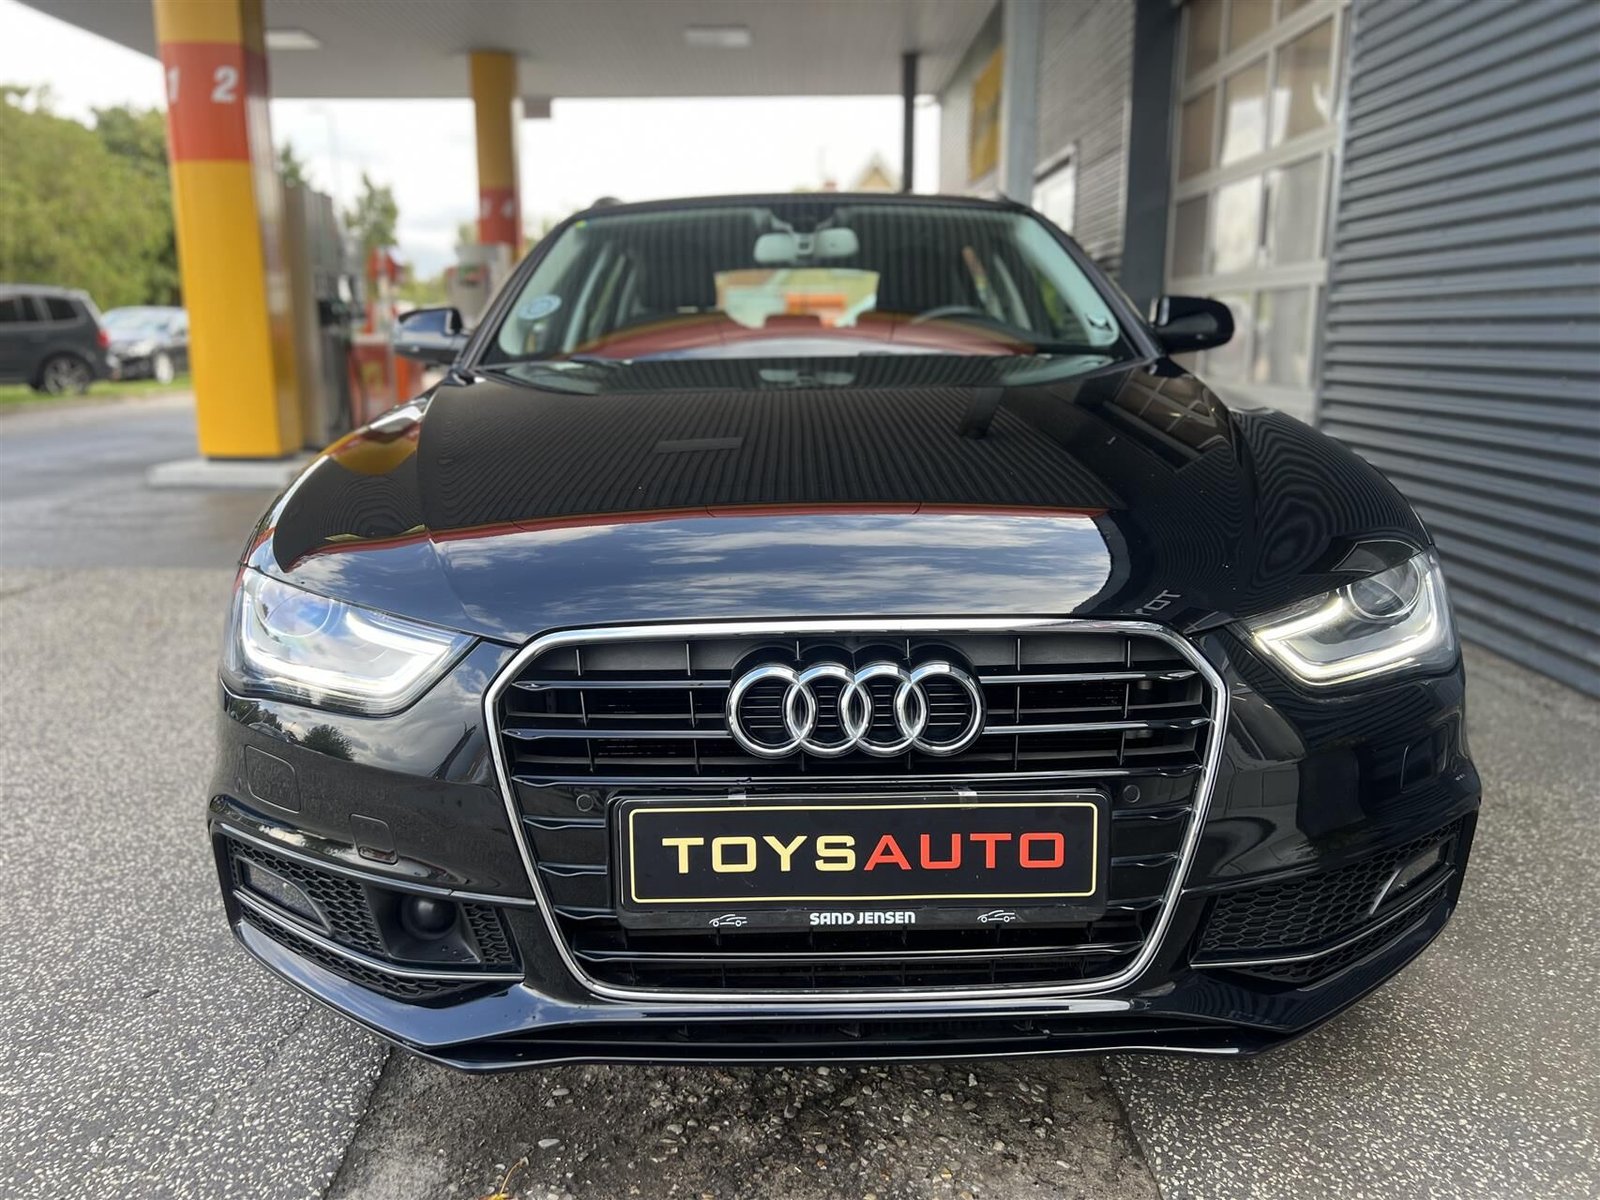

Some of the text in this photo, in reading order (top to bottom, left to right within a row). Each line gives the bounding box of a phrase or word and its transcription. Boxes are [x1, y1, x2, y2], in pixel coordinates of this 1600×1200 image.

[167, 64, 240, 105] 1 2
[661, 832, 1065, 874] TOYSAUTO
[808, 911, 916, 926] SAND JENSEN
